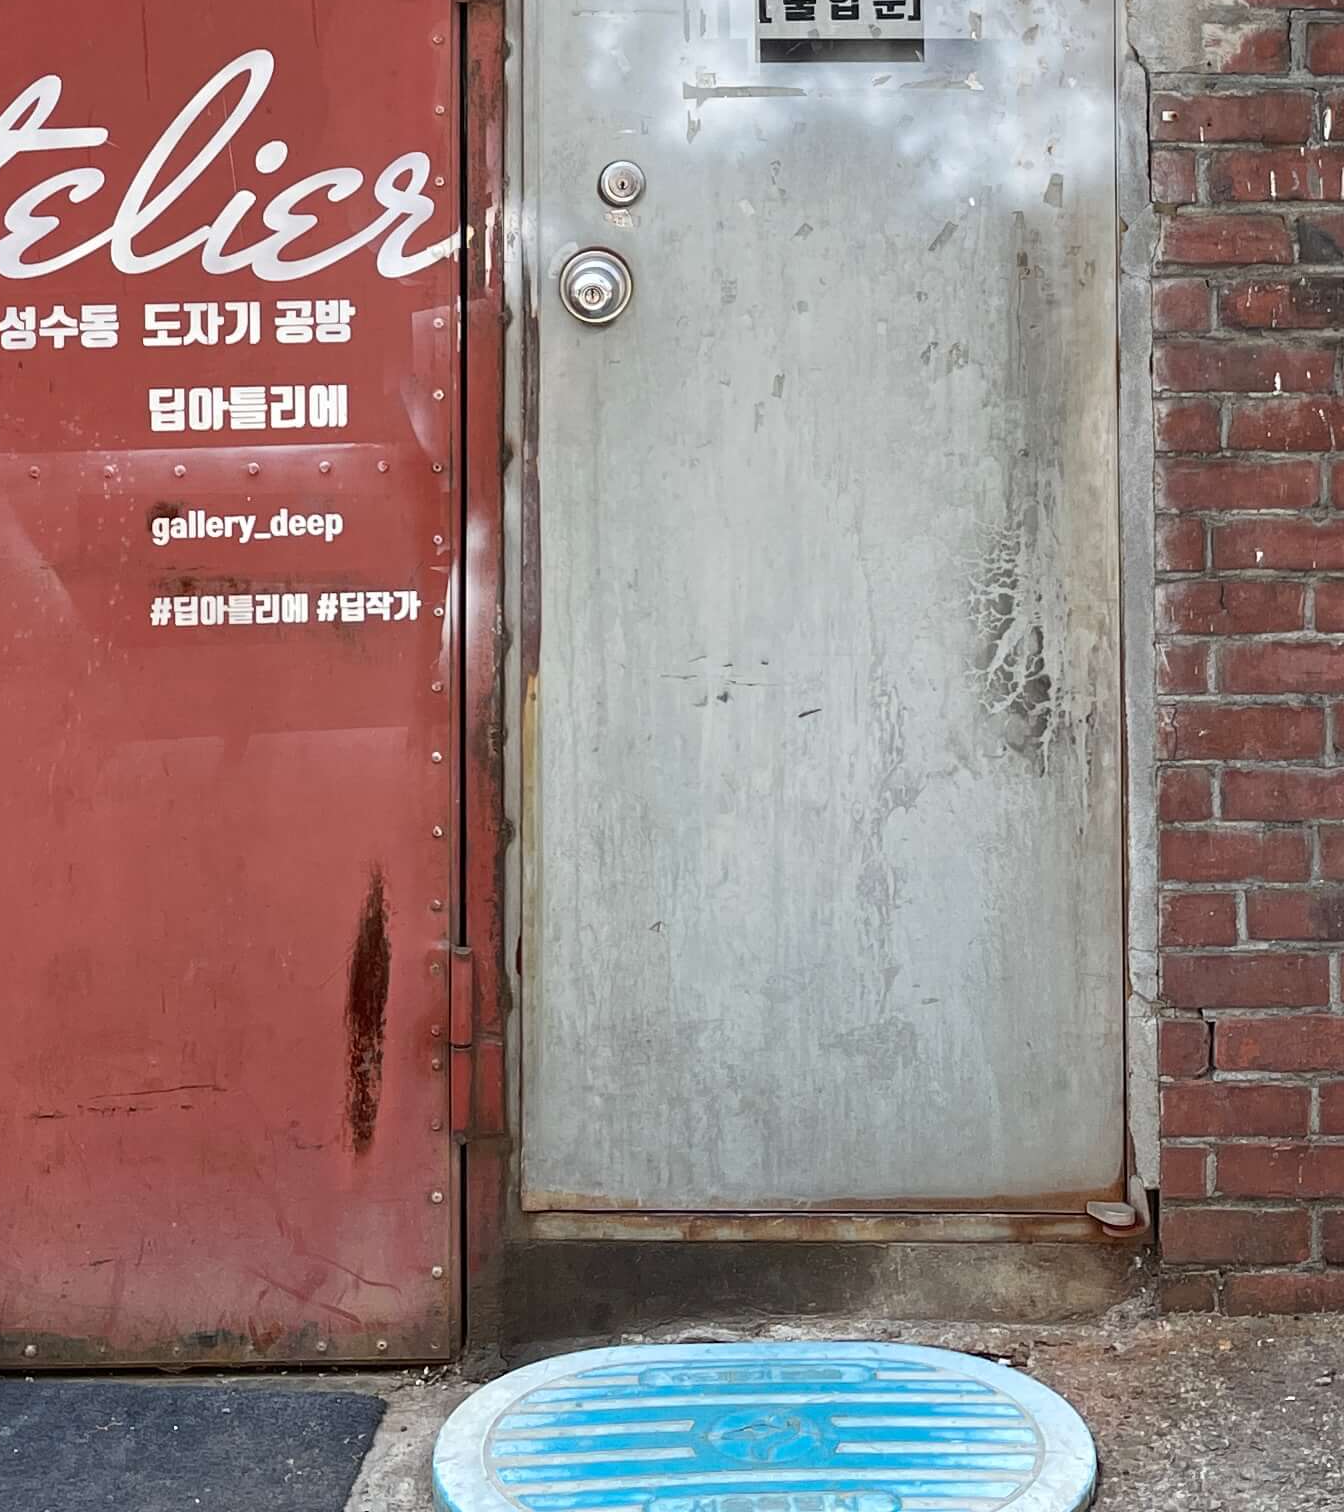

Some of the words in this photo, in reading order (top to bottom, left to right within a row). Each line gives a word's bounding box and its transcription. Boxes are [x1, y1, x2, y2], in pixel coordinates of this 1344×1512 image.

[143, 301, 261, 347] 도자기
[274, 299, 356, 344] 공방
[149, 385, 349, 432] 딥아틀리에
[152, 510, 344, 546] gallery_deep
[150, 593, 309, 626] #딥아틀리에
[317, 590, 422, 622] #딥작가
